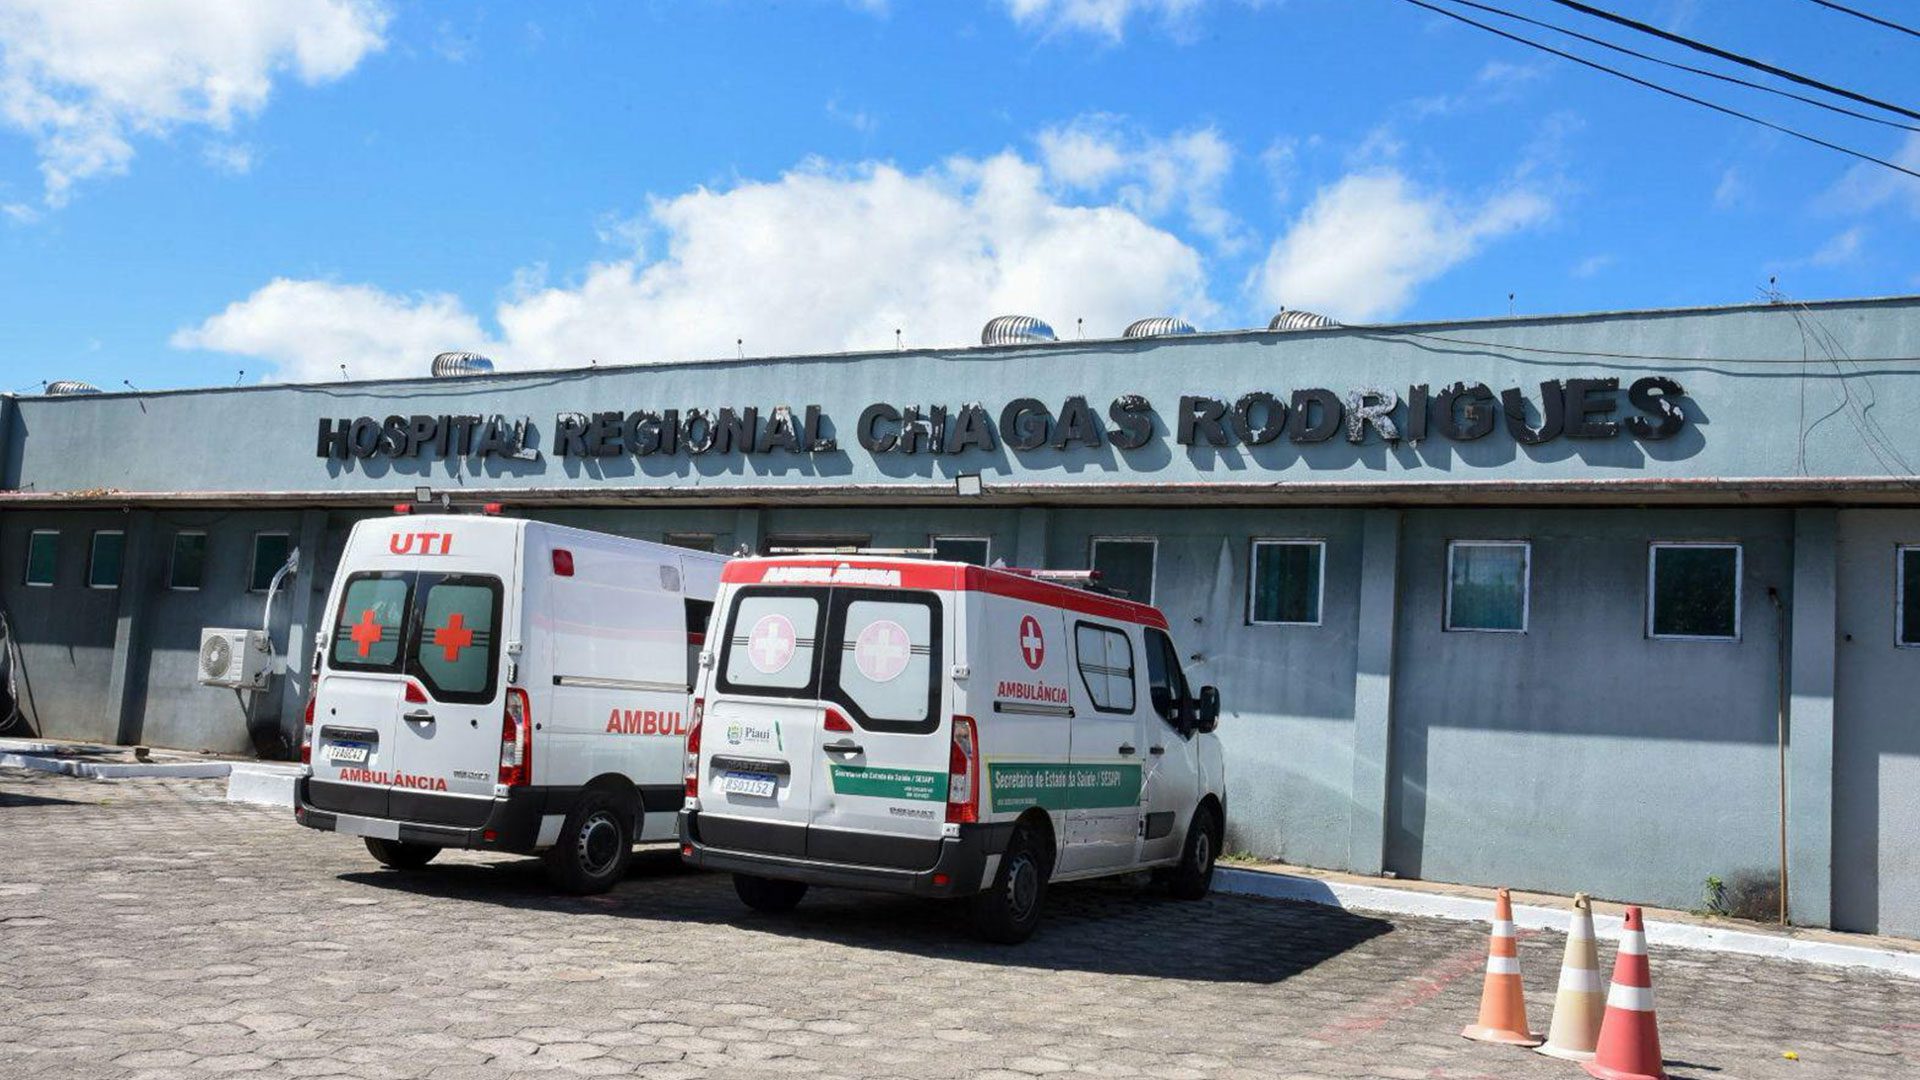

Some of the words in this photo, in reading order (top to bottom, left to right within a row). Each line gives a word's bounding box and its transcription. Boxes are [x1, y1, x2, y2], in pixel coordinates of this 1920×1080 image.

[316, 412, 539, 461] HOSPITAL
[553, 404, 837, 457] REGIONAL
[857, 394, 1154, 454] CHAGAS
[1176, 376, 1690, 448] RODRIGUES
[389, 533, 453, 555] UTI
[997, 680, 1068, 703] AMBULÂNCIA
[339, 767, 448, 792] AMBULÂNCIA
[995, 771, 1034, 788] Secretaria
[1035, 771, 1044, 788] de
[1045, 770, 1066, 787] Estado
[1068, 771, 1075, 787] da
